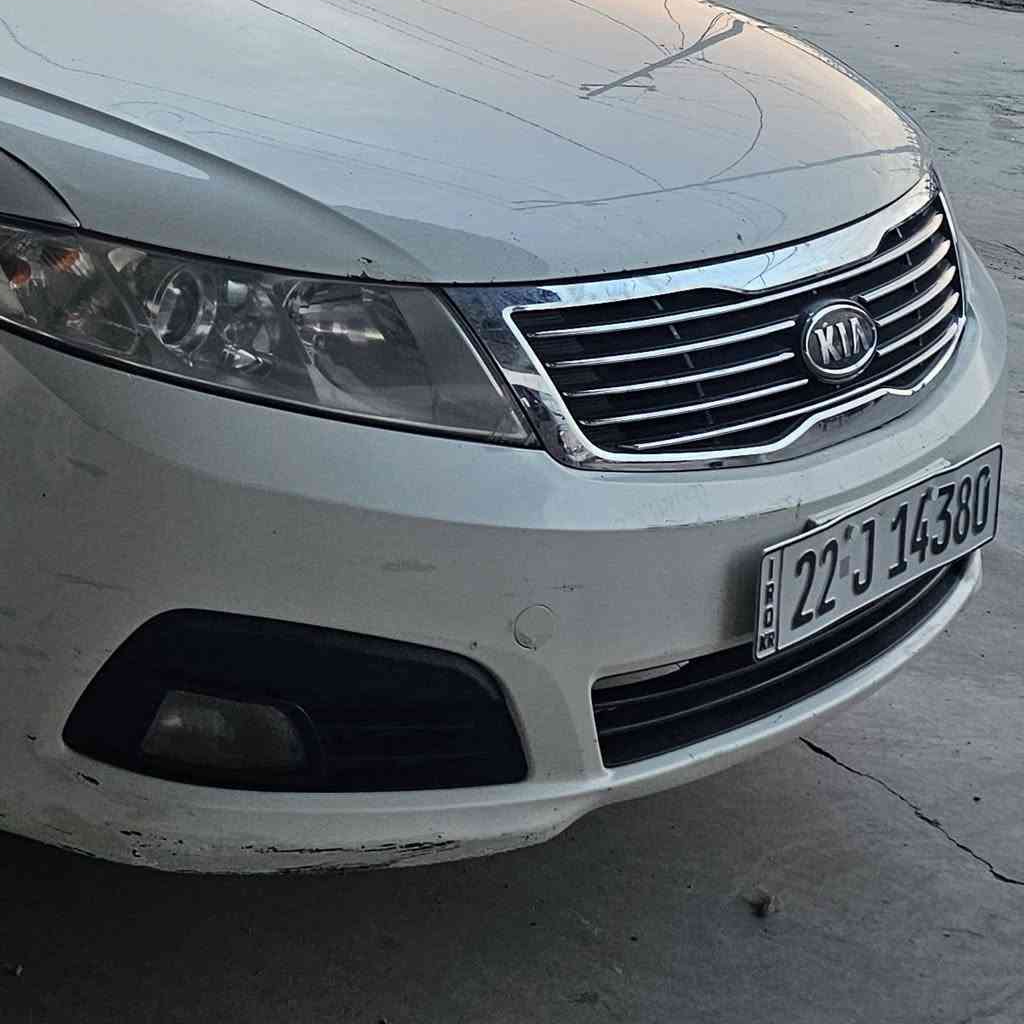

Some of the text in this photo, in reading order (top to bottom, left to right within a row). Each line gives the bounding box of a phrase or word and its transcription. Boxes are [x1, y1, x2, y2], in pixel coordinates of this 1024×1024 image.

[790, 465, 992, 631] 22 J 14380
